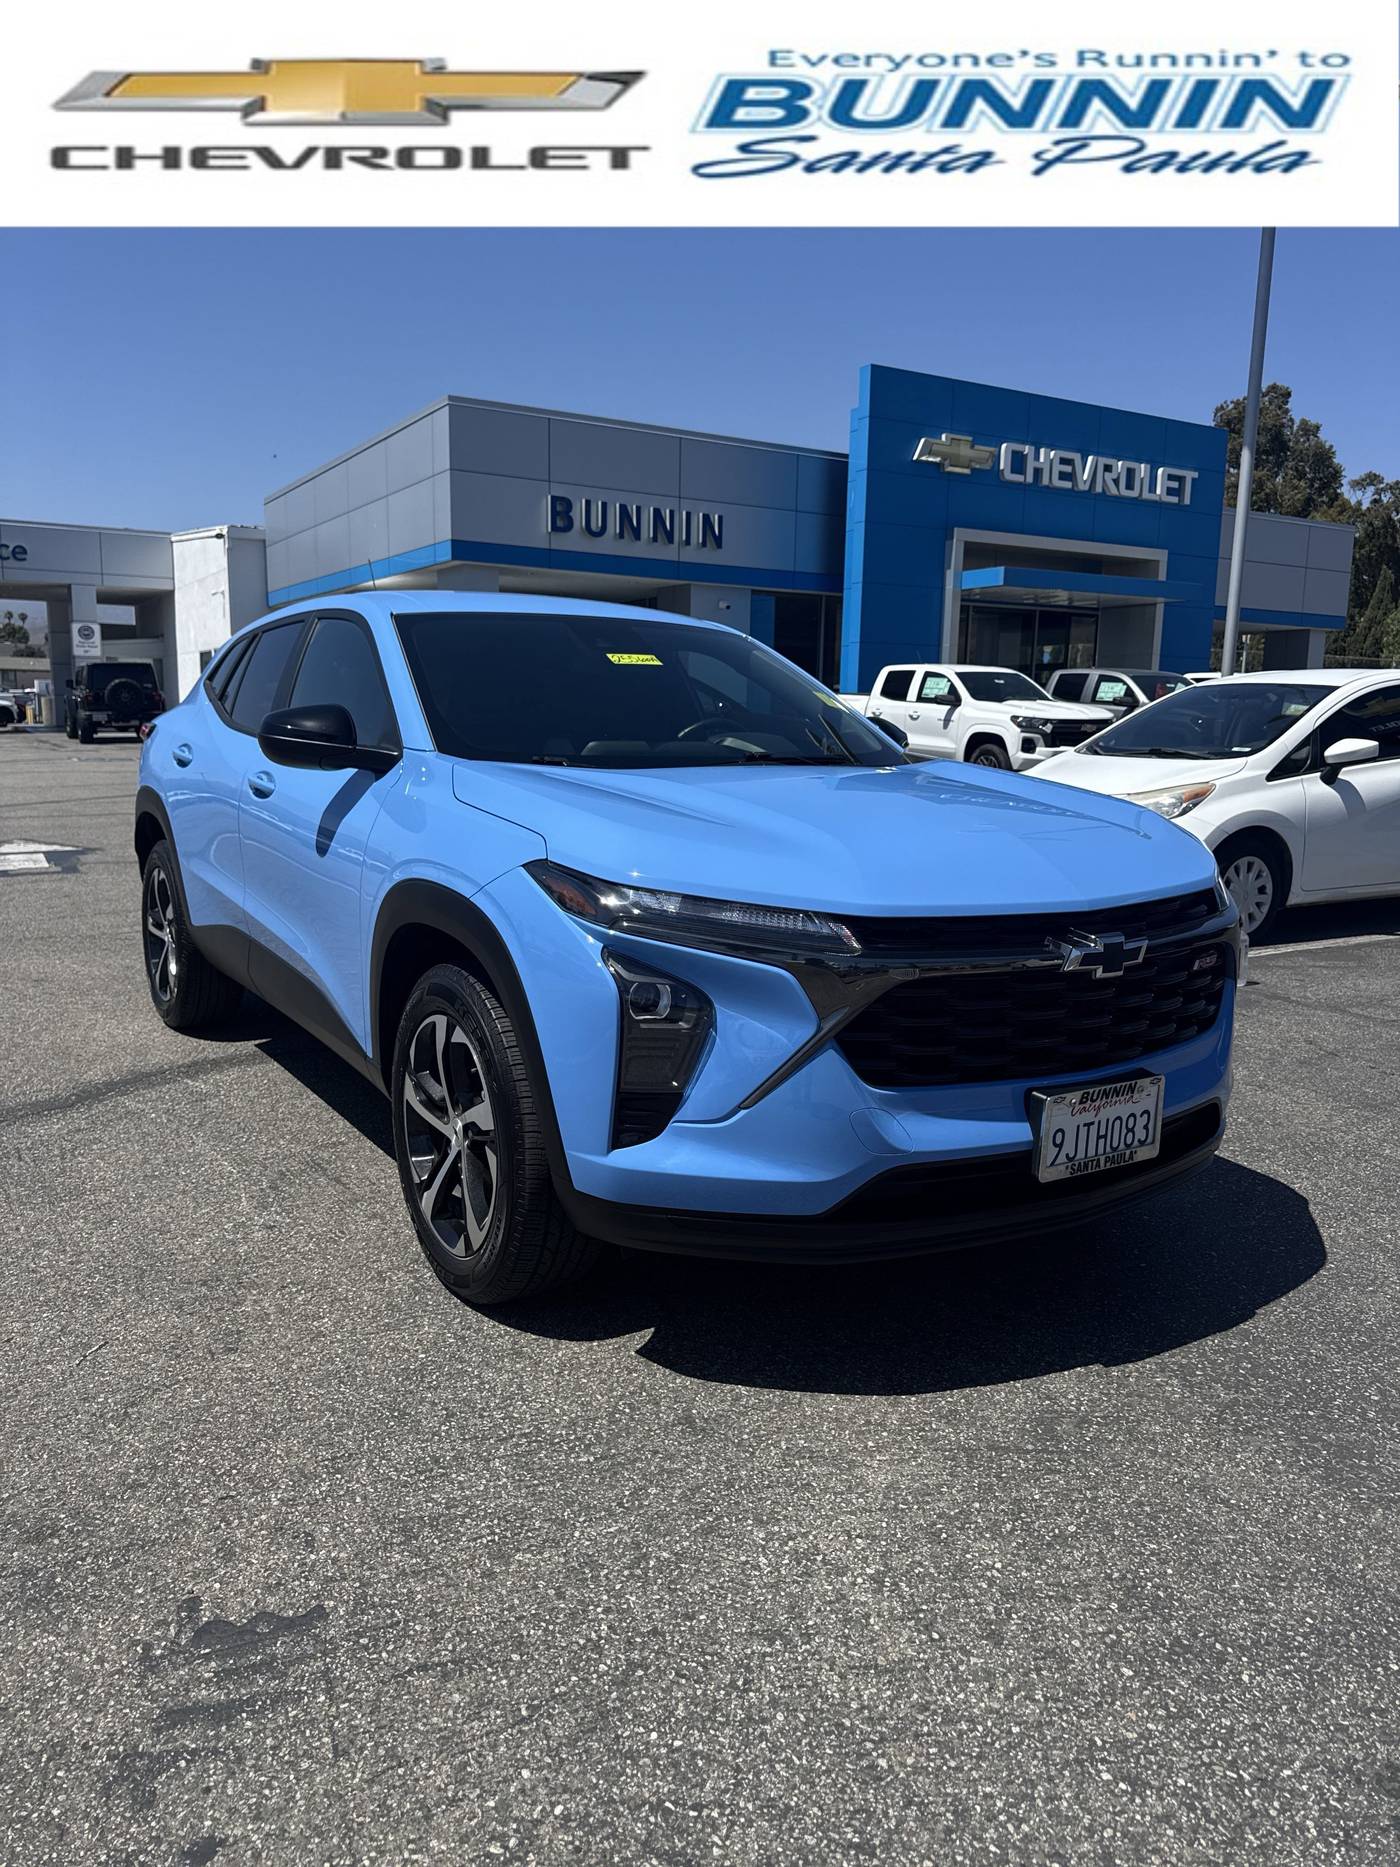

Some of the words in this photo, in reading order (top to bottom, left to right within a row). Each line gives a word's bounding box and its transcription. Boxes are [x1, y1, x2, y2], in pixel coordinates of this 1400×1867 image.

[1000, 442, 1198, 505] CHEVROLET
[547, 494, 723, 549] BUNNIN
[1079, 1081, 1138, 1105] BUNNIN
[1050, 1109, 1151, 1167] 9JTH083
